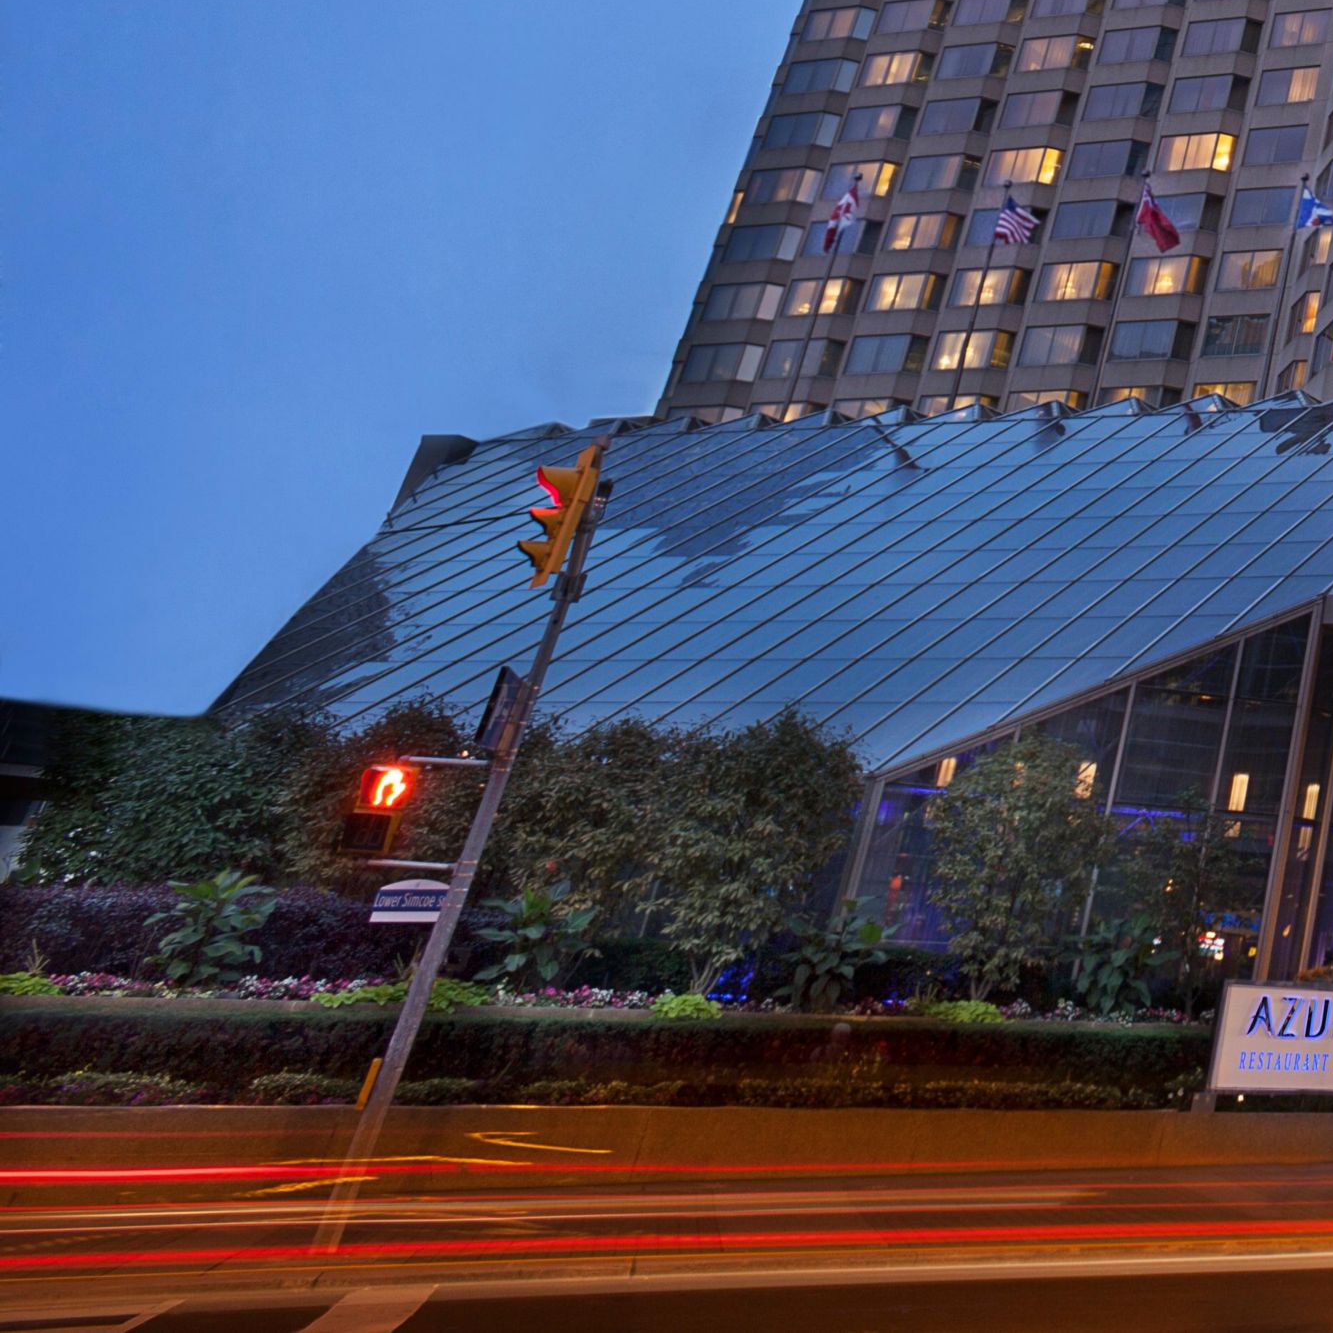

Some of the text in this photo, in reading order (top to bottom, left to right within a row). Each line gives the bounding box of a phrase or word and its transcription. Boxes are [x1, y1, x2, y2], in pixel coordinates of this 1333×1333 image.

[374, 891, 401, 907] Lower
[402, 892, 436, 907] Simcoe
[1239, 1050, 1329, 1072] RESTAURANT
